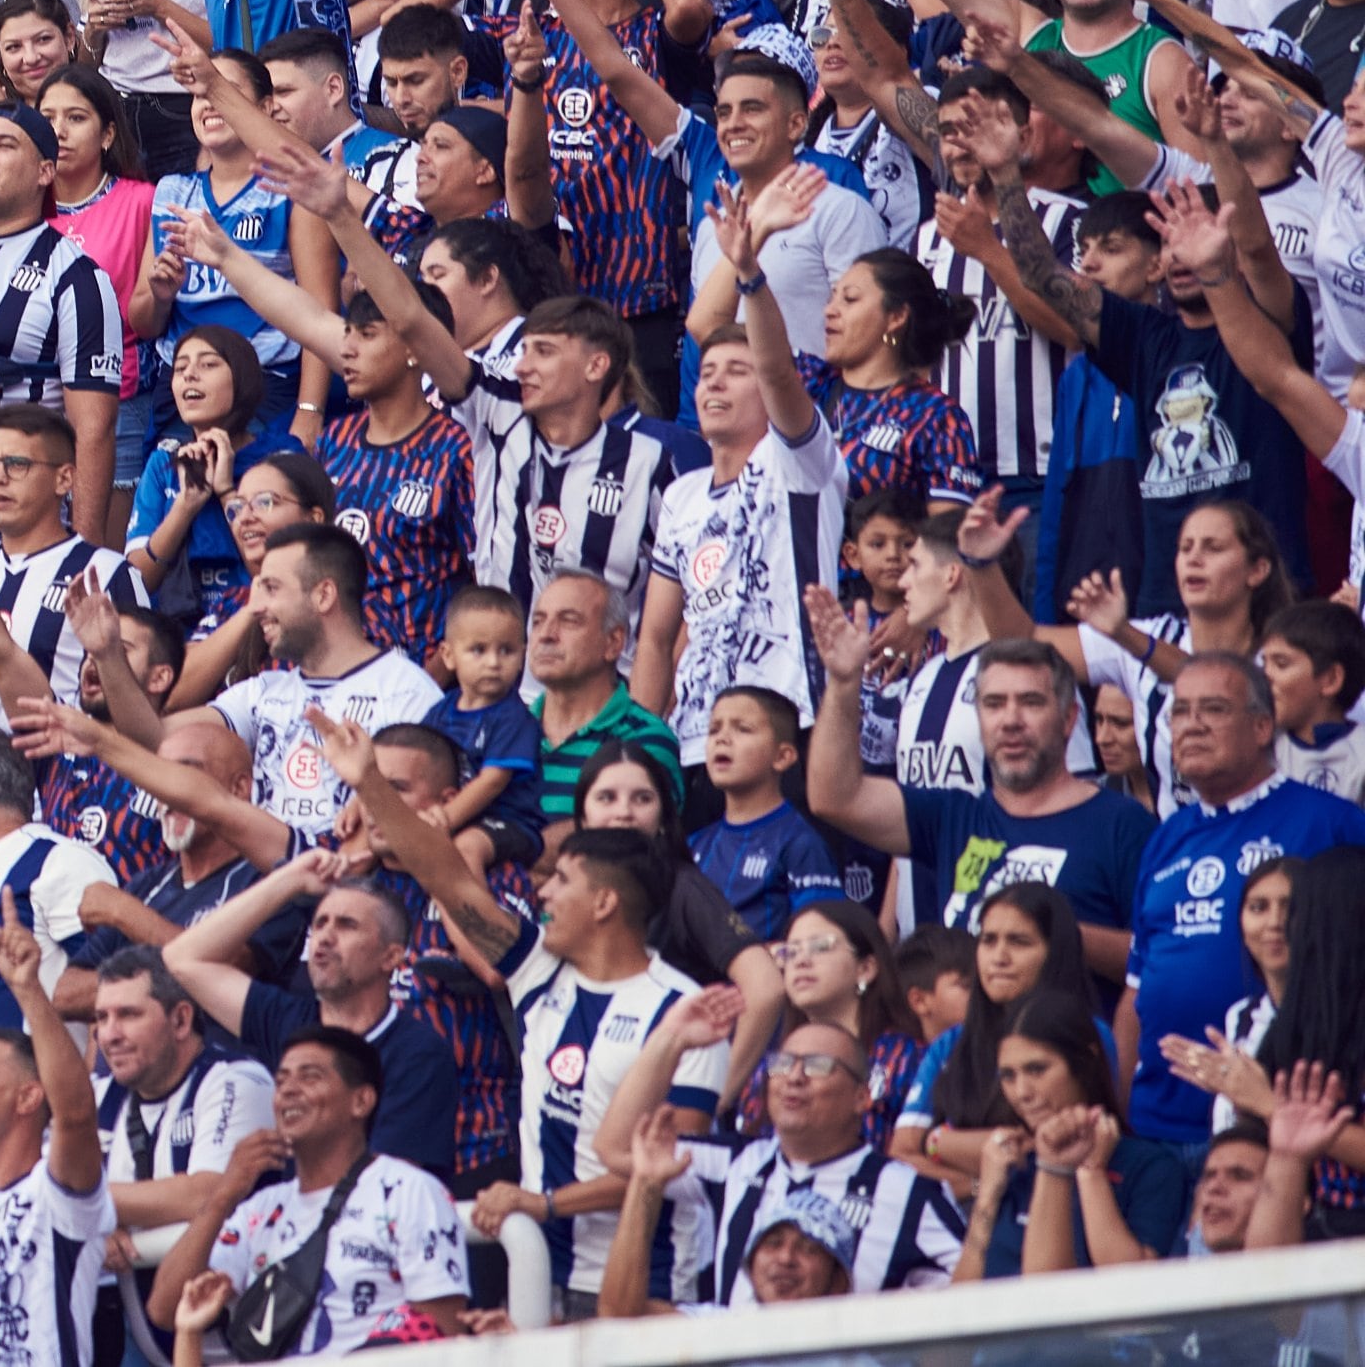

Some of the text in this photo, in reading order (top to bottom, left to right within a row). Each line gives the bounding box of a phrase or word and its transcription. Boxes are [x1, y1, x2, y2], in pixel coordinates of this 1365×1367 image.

[550, 130, 595, 146] ICBC
[973, 294, 1031, 344] VA
[201, 569, 228, 586] BC
[692, 581, 734, 614] ICBC
[281, 798, 328, 816] ICBC
[1175, 899, 1224, 925] ICBC
